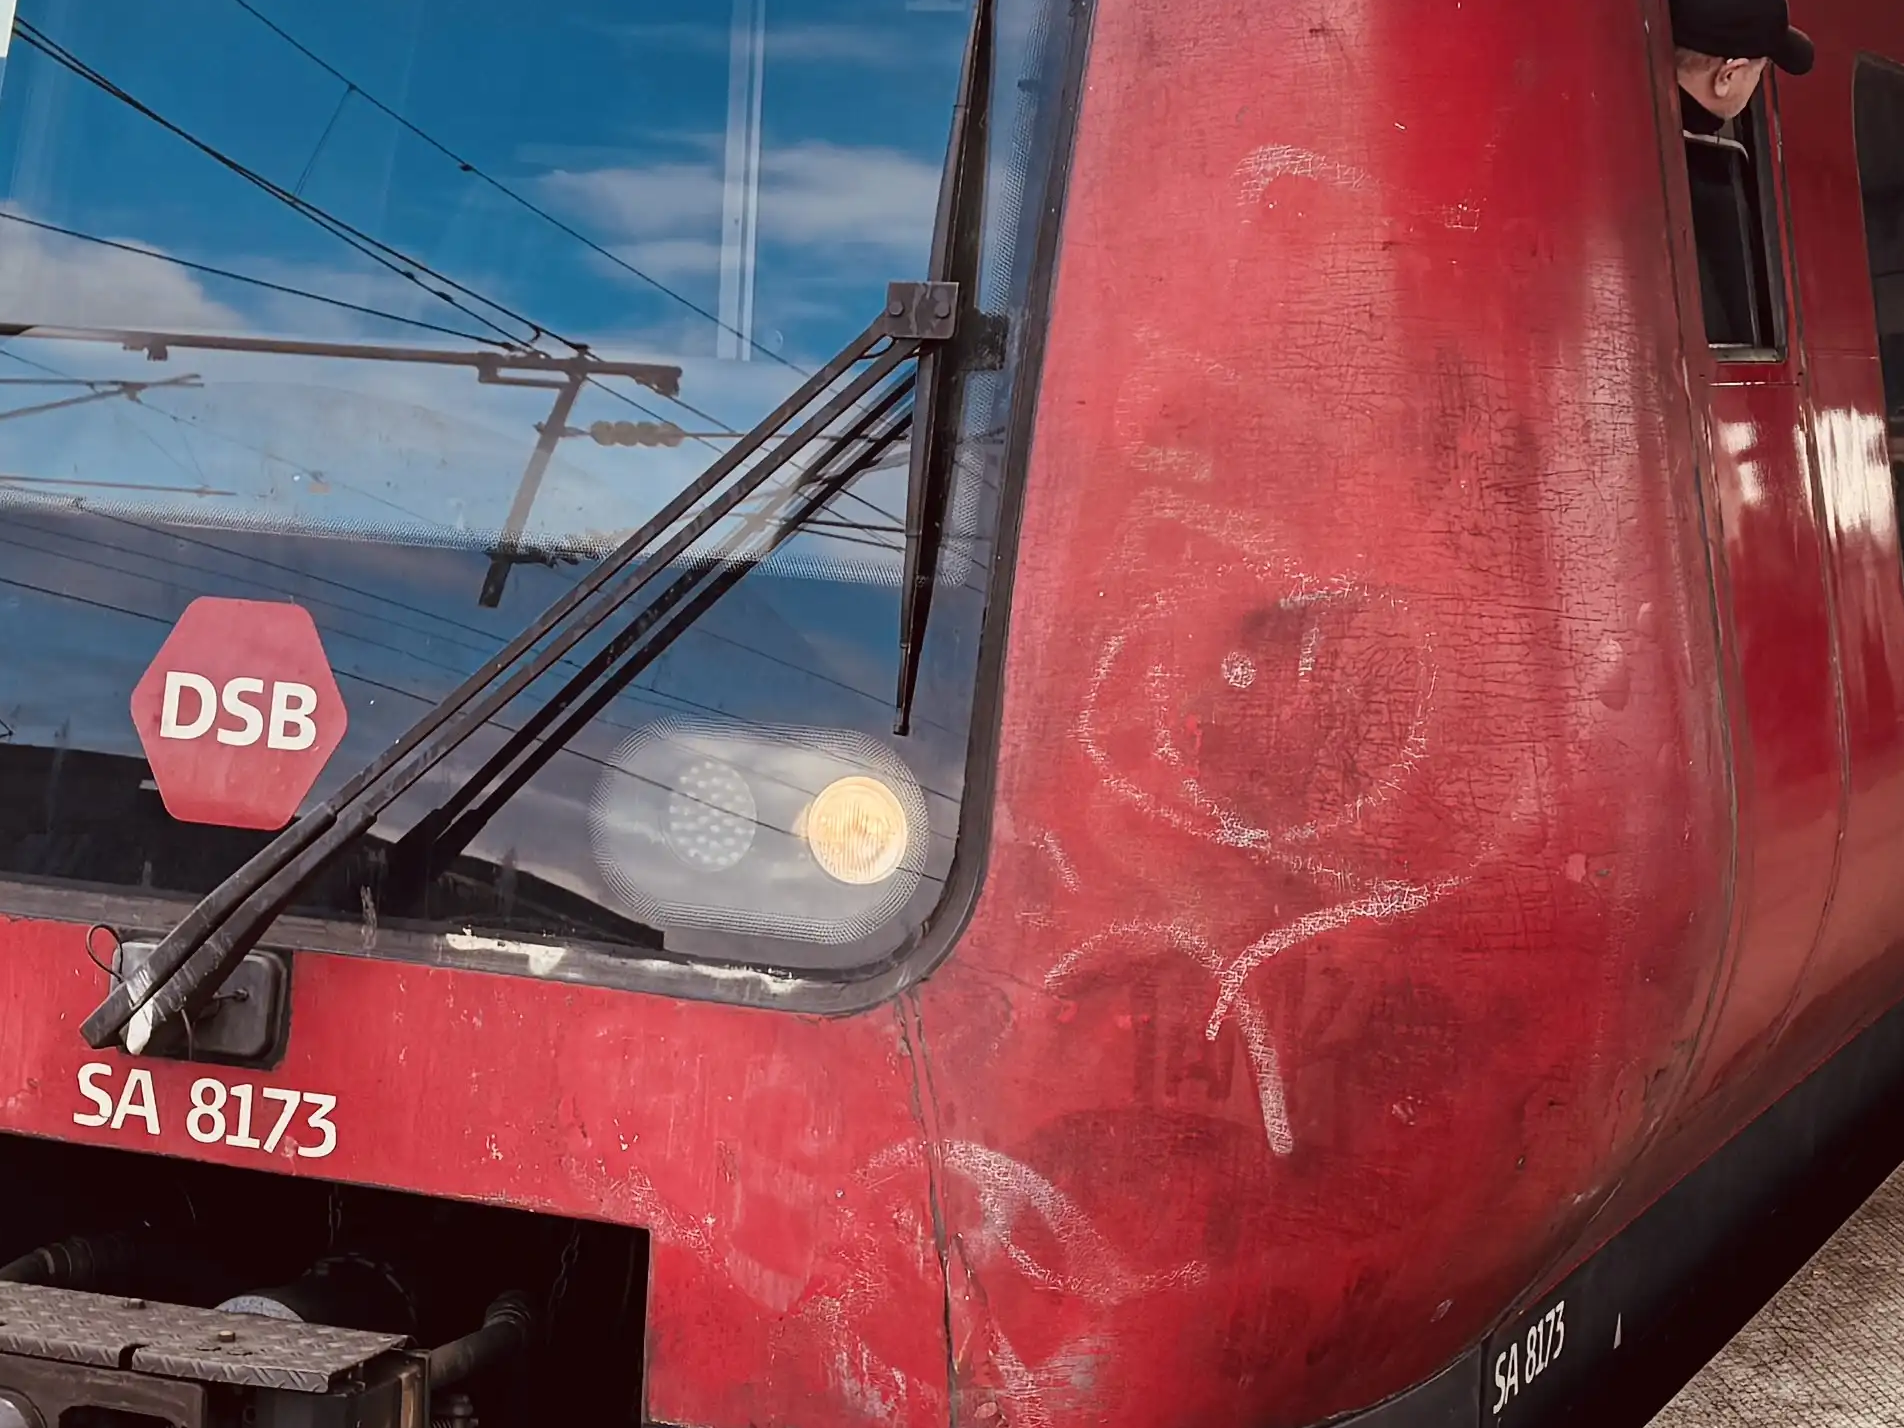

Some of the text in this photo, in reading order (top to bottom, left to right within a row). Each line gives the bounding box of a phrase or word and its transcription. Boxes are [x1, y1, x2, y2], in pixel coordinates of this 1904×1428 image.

[159, 670, 319, 751] DSB
[72, 1062, 338, 1158] SA 8173
[1492, 1300, 1565, 1415] SA 8173
